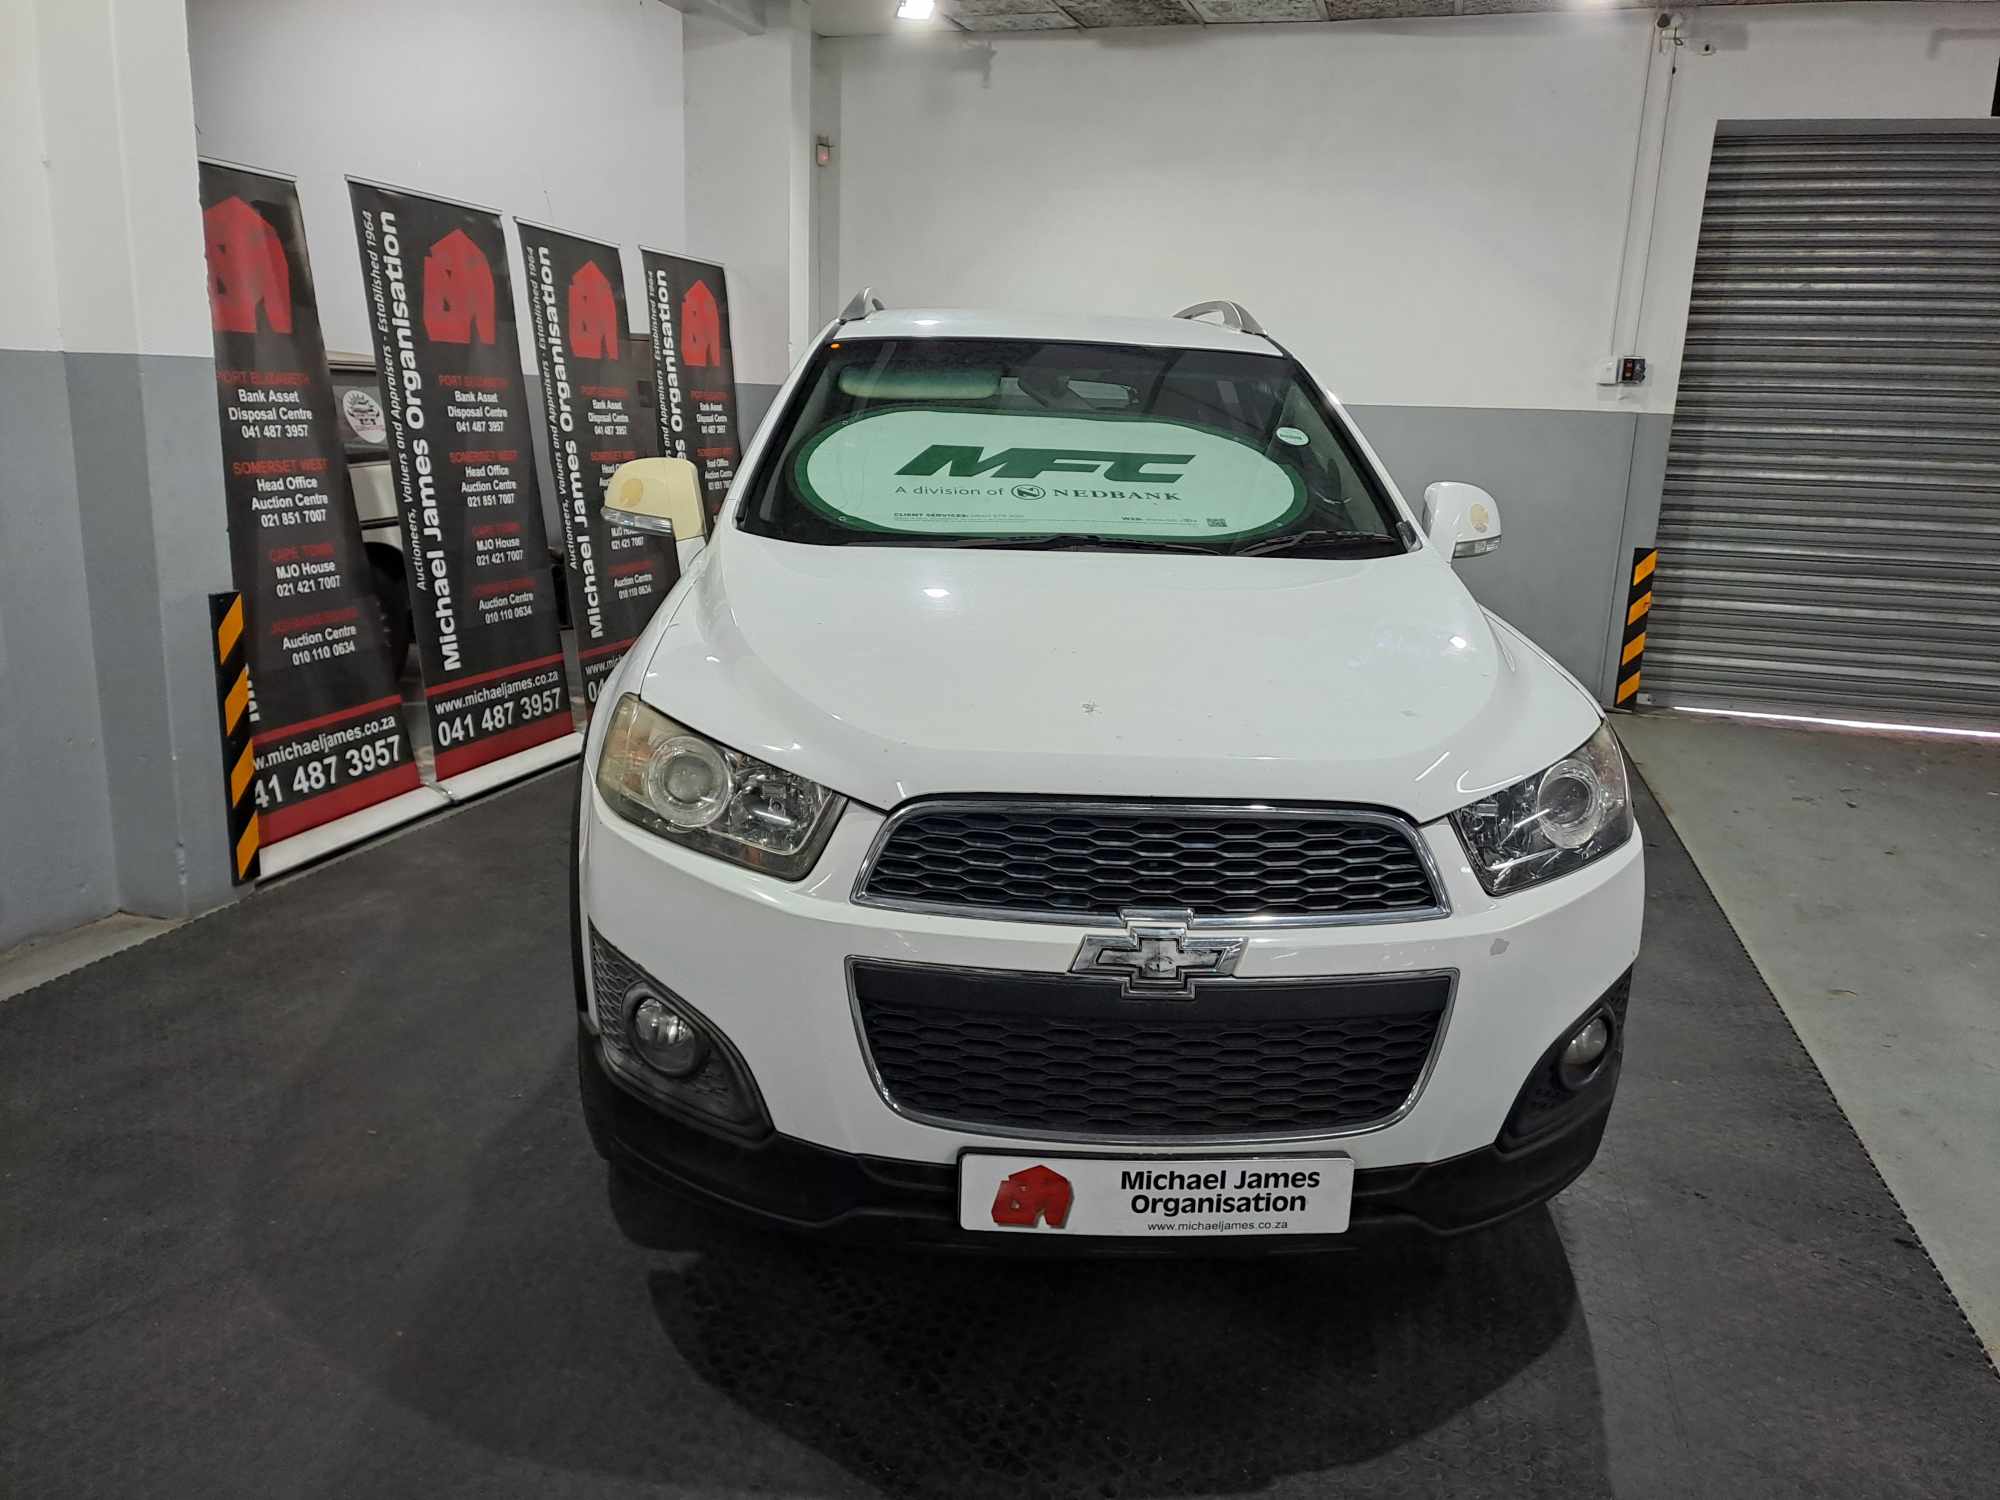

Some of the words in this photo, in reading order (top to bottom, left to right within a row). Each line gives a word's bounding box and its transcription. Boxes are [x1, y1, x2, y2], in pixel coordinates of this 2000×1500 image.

[362, 210, 377, 247] 1964
[367, 249, 389, 333] Established
[380, 211, 425, 430] Organisation
[538, 246, 574, 432] Organisation
[656, 269, 683, 432] Organisation
[383, 344, 402, 420] Appraisers
[542, 360, 558, 424] Appraisers
[238, 389, 267, 402] Bank
[268, 390, 300, 403] Asset
[227, 407, 277, 423] Disposal
[279, 407, 312, 420] Centre
[447, 406, 483, 420] Disposal
[241, 425, 260, 438] 041
[263, 424, 281, 438] 487
[285, 424, 308, 438] 3957
[391, 421, 406, 450] and
[455, 421, 470, 432] 041
[549, 425, 560, 449] and
[465, 465, 485, 478] Head
[555, 451, 567, 495] Valuers
[893, 444, 1197, 484] MFC
[256, 478, 284, 492] Head
[286, 476, 318, 490] Office
[398, 451, 413, 503] Valuers
[461, 481, 491, 493] Auction
[493, 480, 517, 490] Centre
[565, 439, 588, 528] James
[251, 496, 293, 510] Auction
[295, 493, 328, 506] Centre
[412, 438, 442, 542] James
[467, 496, 481, 507] 021
[895, 486, 906, 494] A
[913, 486, 981, 496] division
[986, 487, 1005, 496] of
[1053, 489, 1183, 501] NEDBANK
[261, 514, 279, 528] 021
[281, 511, 301, 525] 851
[303, 509, 326, 523] 7007
[407, 508, 427, 592] Auctioneers,
[476, 539, 494, 551] MJO
[495, 537, 520, 549] House
[476, 555, 490, 566] 021
[491, 552, 505, 564] 421
[506, 549, 524, 561] 7007
[276, 564, 300, 579] MJO
[301, 561, 336, 576] House
[276, 583, 295, 597] 021
[297, 580, 316, 593] 421
[318, 575, 341, 590] 7007
[576, 535, 604, 640] Michael
[426, 550, 462, 672] Michael
[478, 596, 509, 611] Auction
[509, 591, 534, 606] Centre
[485, 611, 499, 624] 010
[499, 608, 513, 622] 110
[282, 633, 322, 650] Auction
[324, 625, 357, 640] Centre
[292, 651, 310, 666] 010
[312, 646, 331, 661] 110
[332, 640, 356, 656] 0634
[434, 670, 559, 715] www.michaeljames.co.za
[437, 713, 475, 747] 041
[481, 701, 514, 733] 487
[520, 687, 561, 720] 3957
[292, 755, 337, 794] 487
[345, 735, 400, 777] 3957
[1120, 1170, 1227, 1190] Michael
[1234, 1170, 1320, 1190] James
[1131, 1193, 1306, 1217] Organisation
[1147, 1220, 1288, 1232] www.michaeljames.co.za
